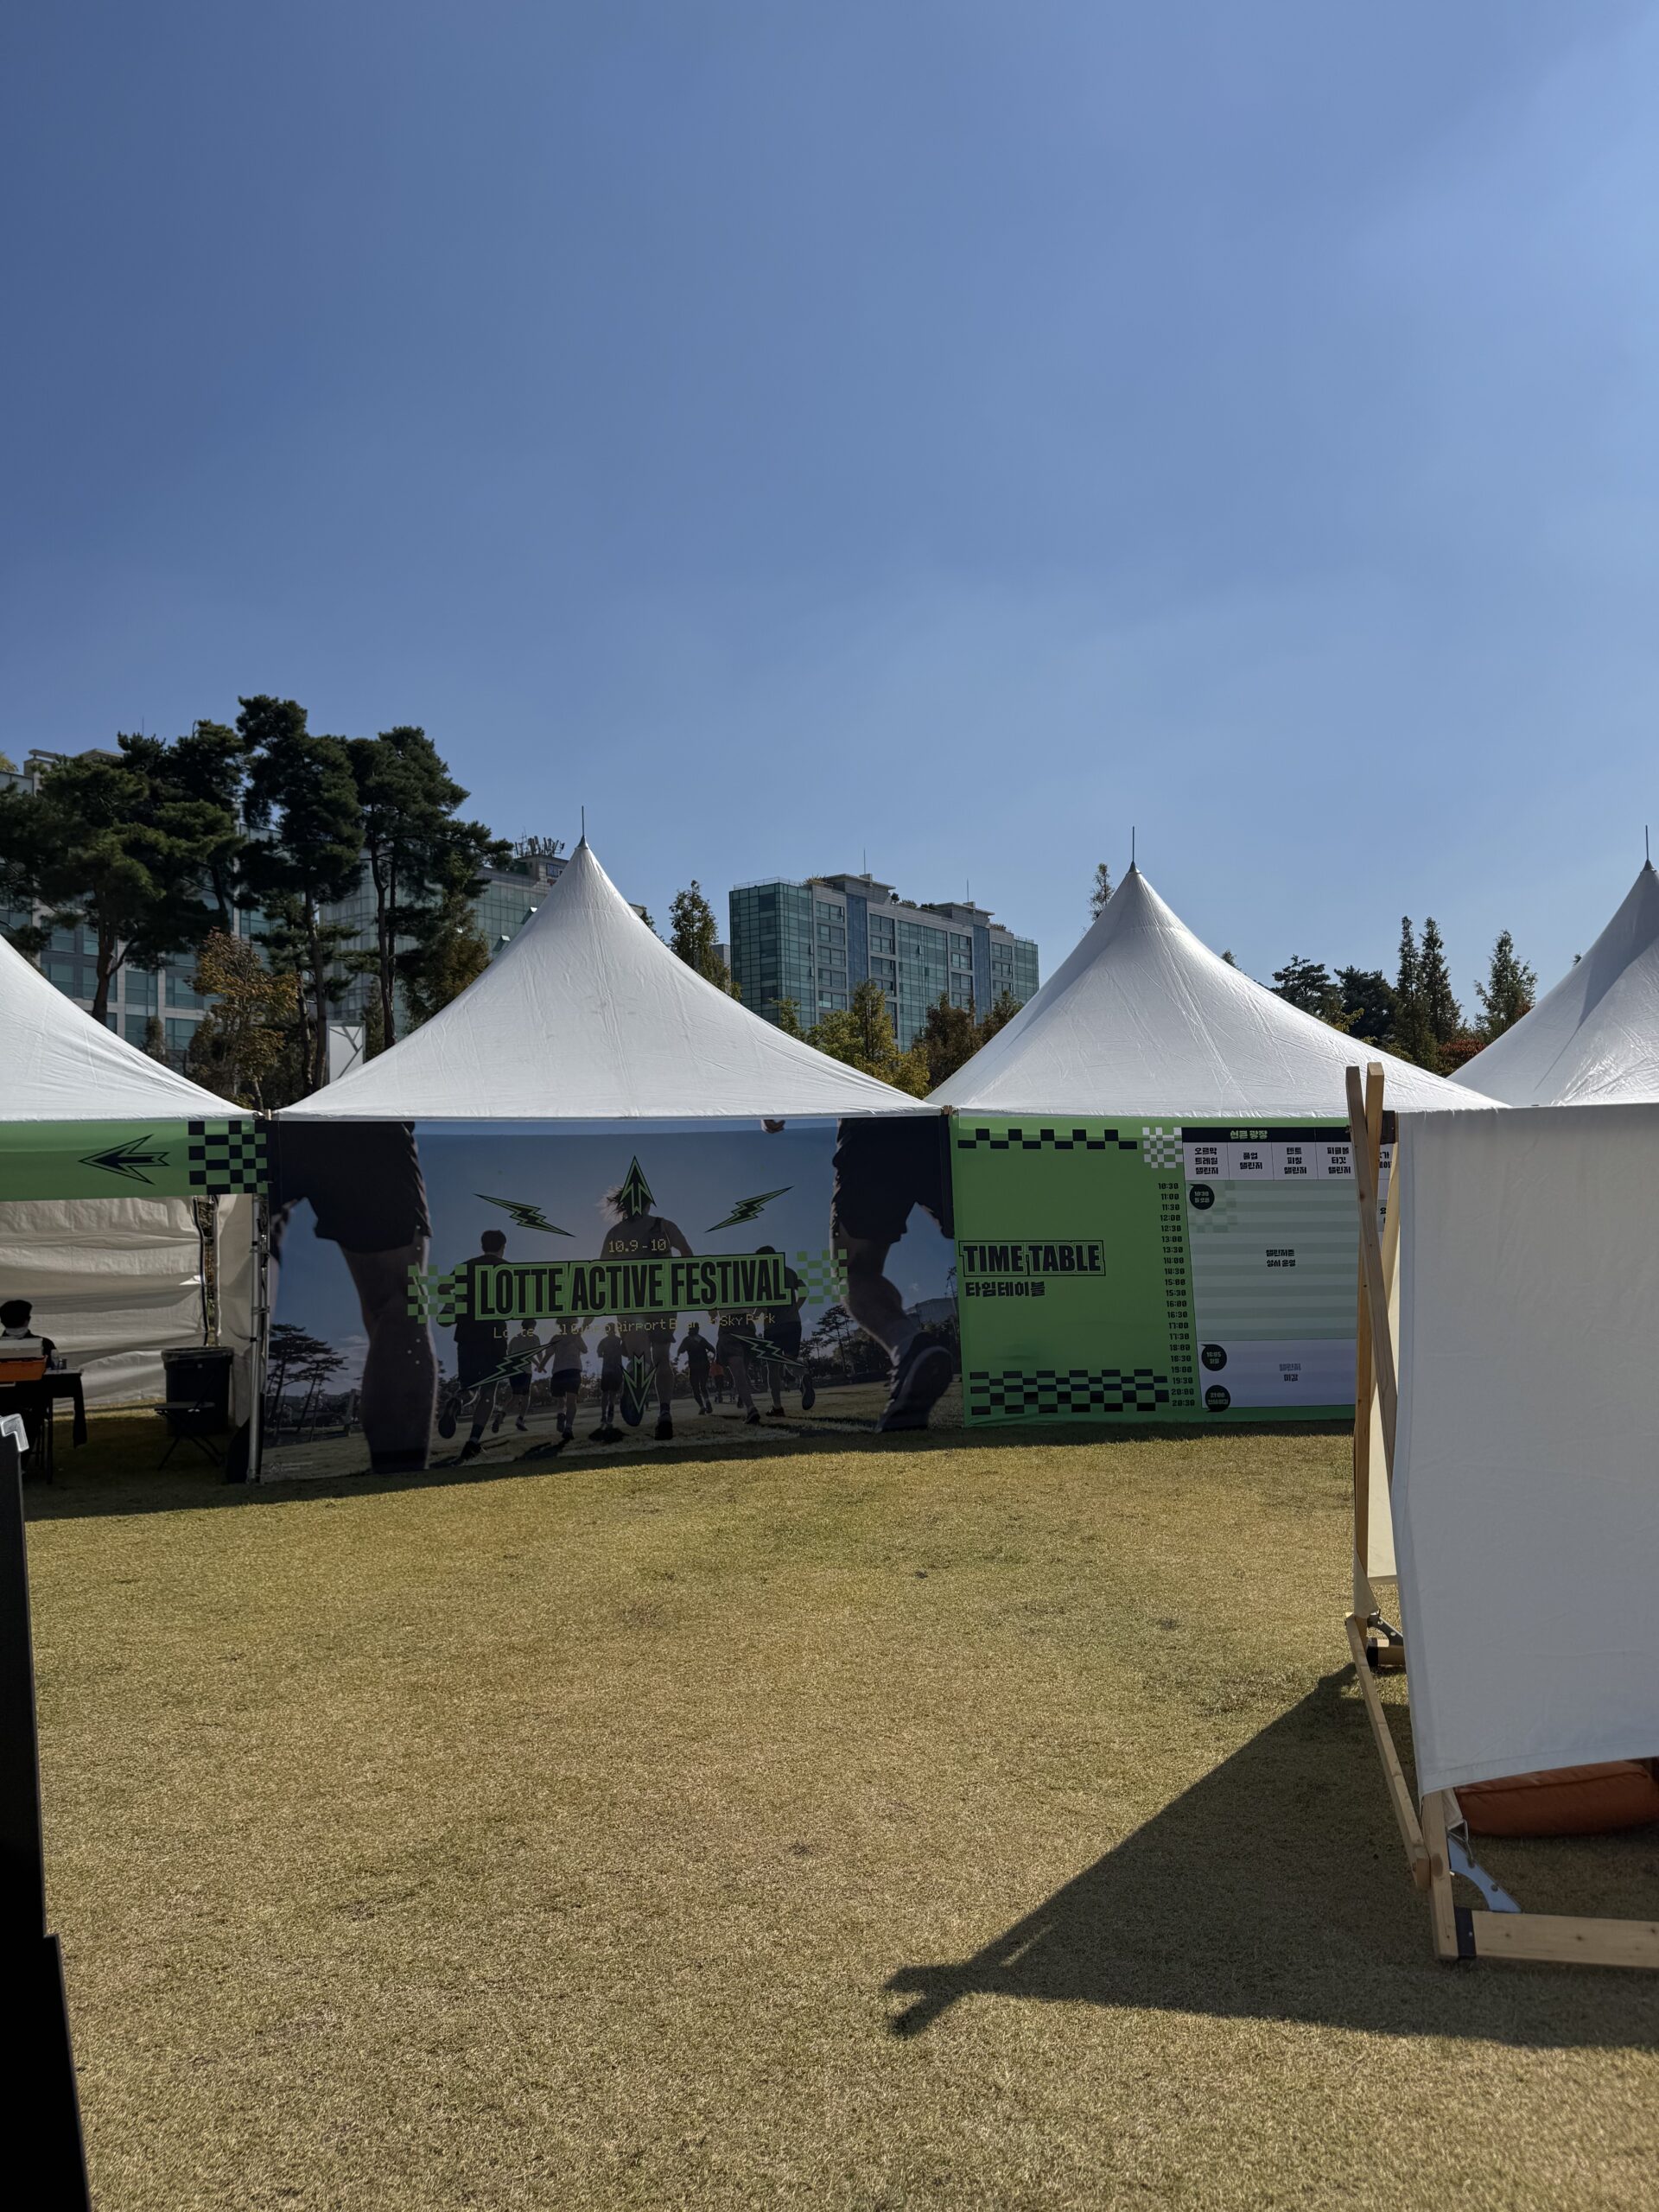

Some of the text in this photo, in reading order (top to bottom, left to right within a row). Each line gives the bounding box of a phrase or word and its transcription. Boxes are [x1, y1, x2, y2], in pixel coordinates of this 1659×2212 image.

[1249, 1130, 1268, 1140] 광장
[1326, 1147, 1350, 1155] 피클볼
[1287, 1156, 1302, 1165] 피칭
[1332, 1156, 1347, 1165] 타깃
[1239, 1161, 1263, 1170] 챌린지
[1328, 1166, 1351, 1174] 챌린지
[1195, 1166, 1219, 1175] 챌린지
[1284, 1166, 1307, 1175] 챌린지
[963, 1244, 1102, 1272] TIME TABLE
[1267, 1259, 1296, 1268] 상시 운영
[480, 1258, 786, 1315] LOTTE ACTIVE FESTIVAL
[965, 1281, 1045, 1297] 타임테이블
[720, 1315, 743, 1327] Sky
